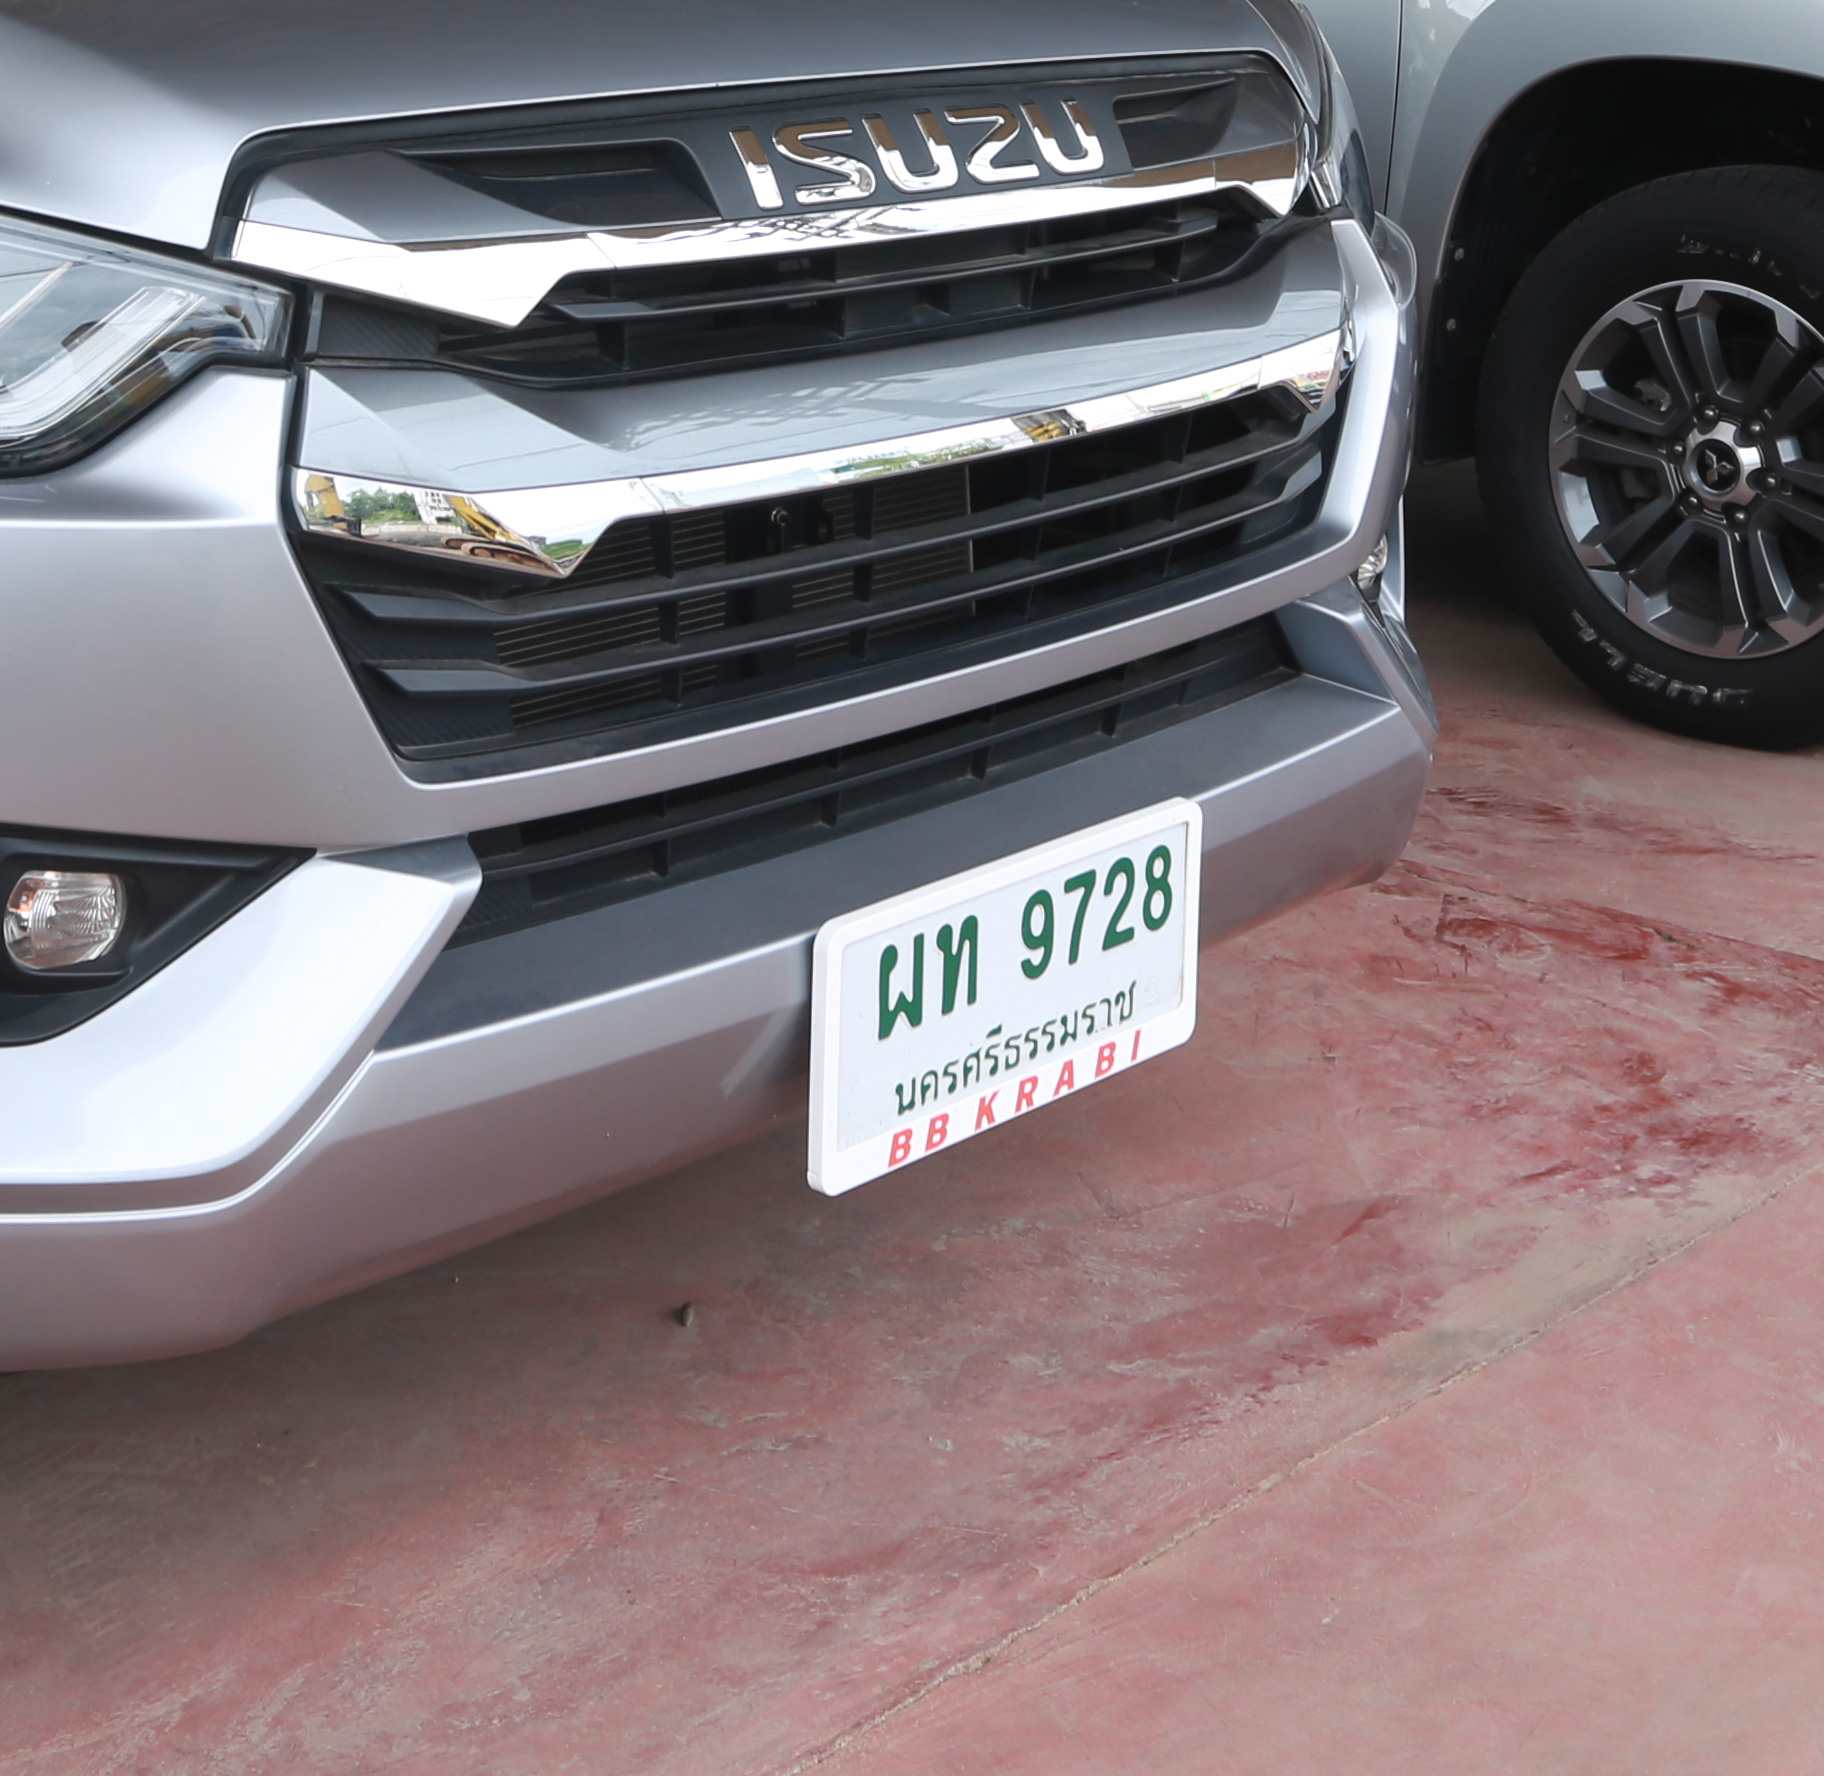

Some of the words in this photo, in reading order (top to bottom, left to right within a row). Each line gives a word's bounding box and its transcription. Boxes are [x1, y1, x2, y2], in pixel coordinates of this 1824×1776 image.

[729, 98, 1104, 211] ISUZU
[877, 914, 980, 1042] ผท
[1019, 843, 1174, 981] 9728
[887, 1112, 950, 1169] BB
[973, 1029, 1143, 1132] KRABI
[894, 980, 1138, 1117] นครศรีธรรมราช
